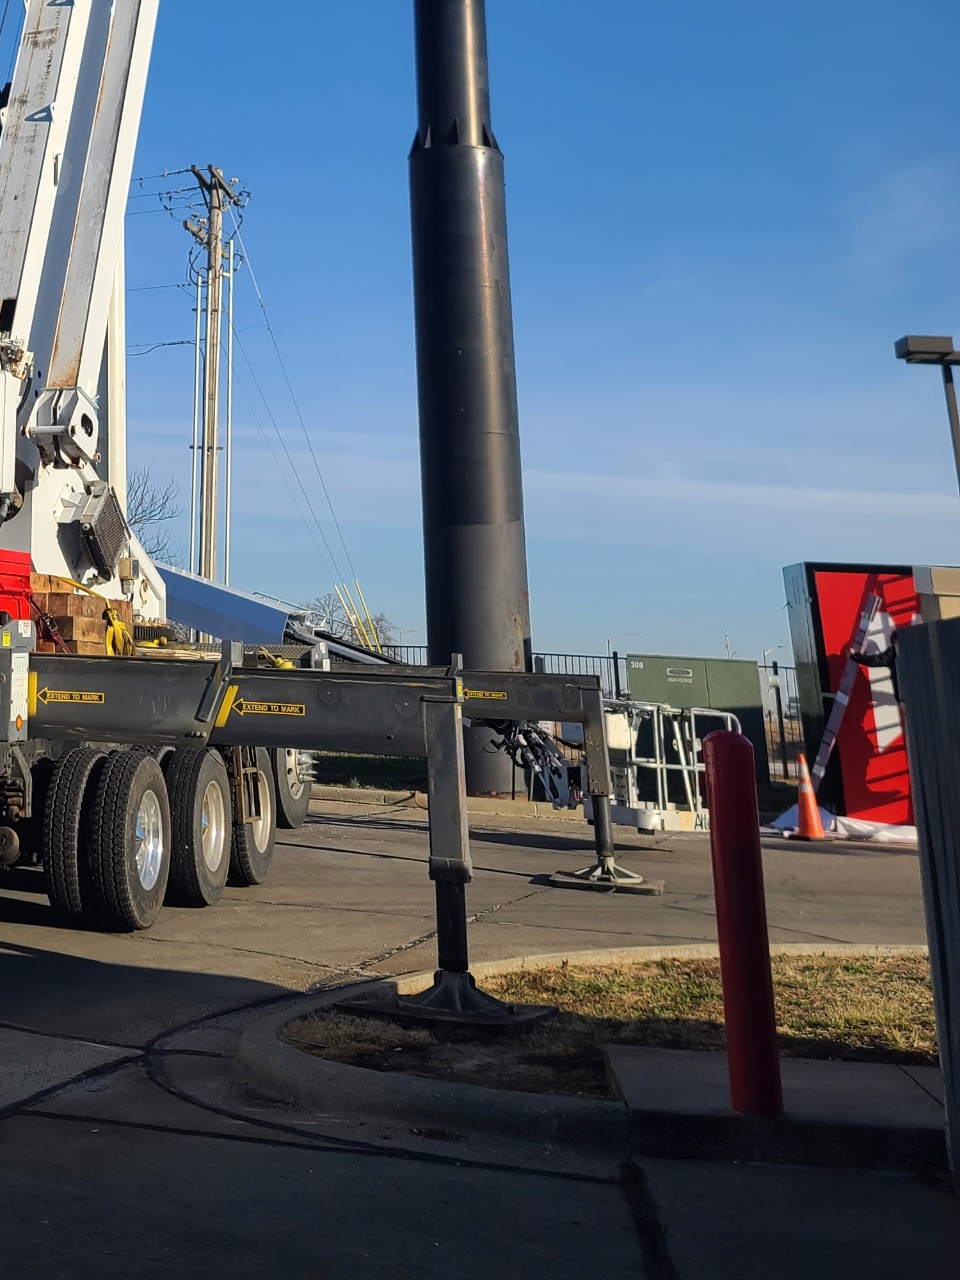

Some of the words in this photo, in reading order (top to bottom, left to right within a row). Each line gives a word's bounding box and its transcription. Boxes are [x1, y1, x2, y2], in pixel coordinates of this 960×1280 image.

[46, 692, 70, 700] EXTEND
[72, 693, 80, 701] TO
[82, 693, 100, 701] MARK
[242, 703, 268, 711] EXTEND
[694, 812, 710, 830] Alt
